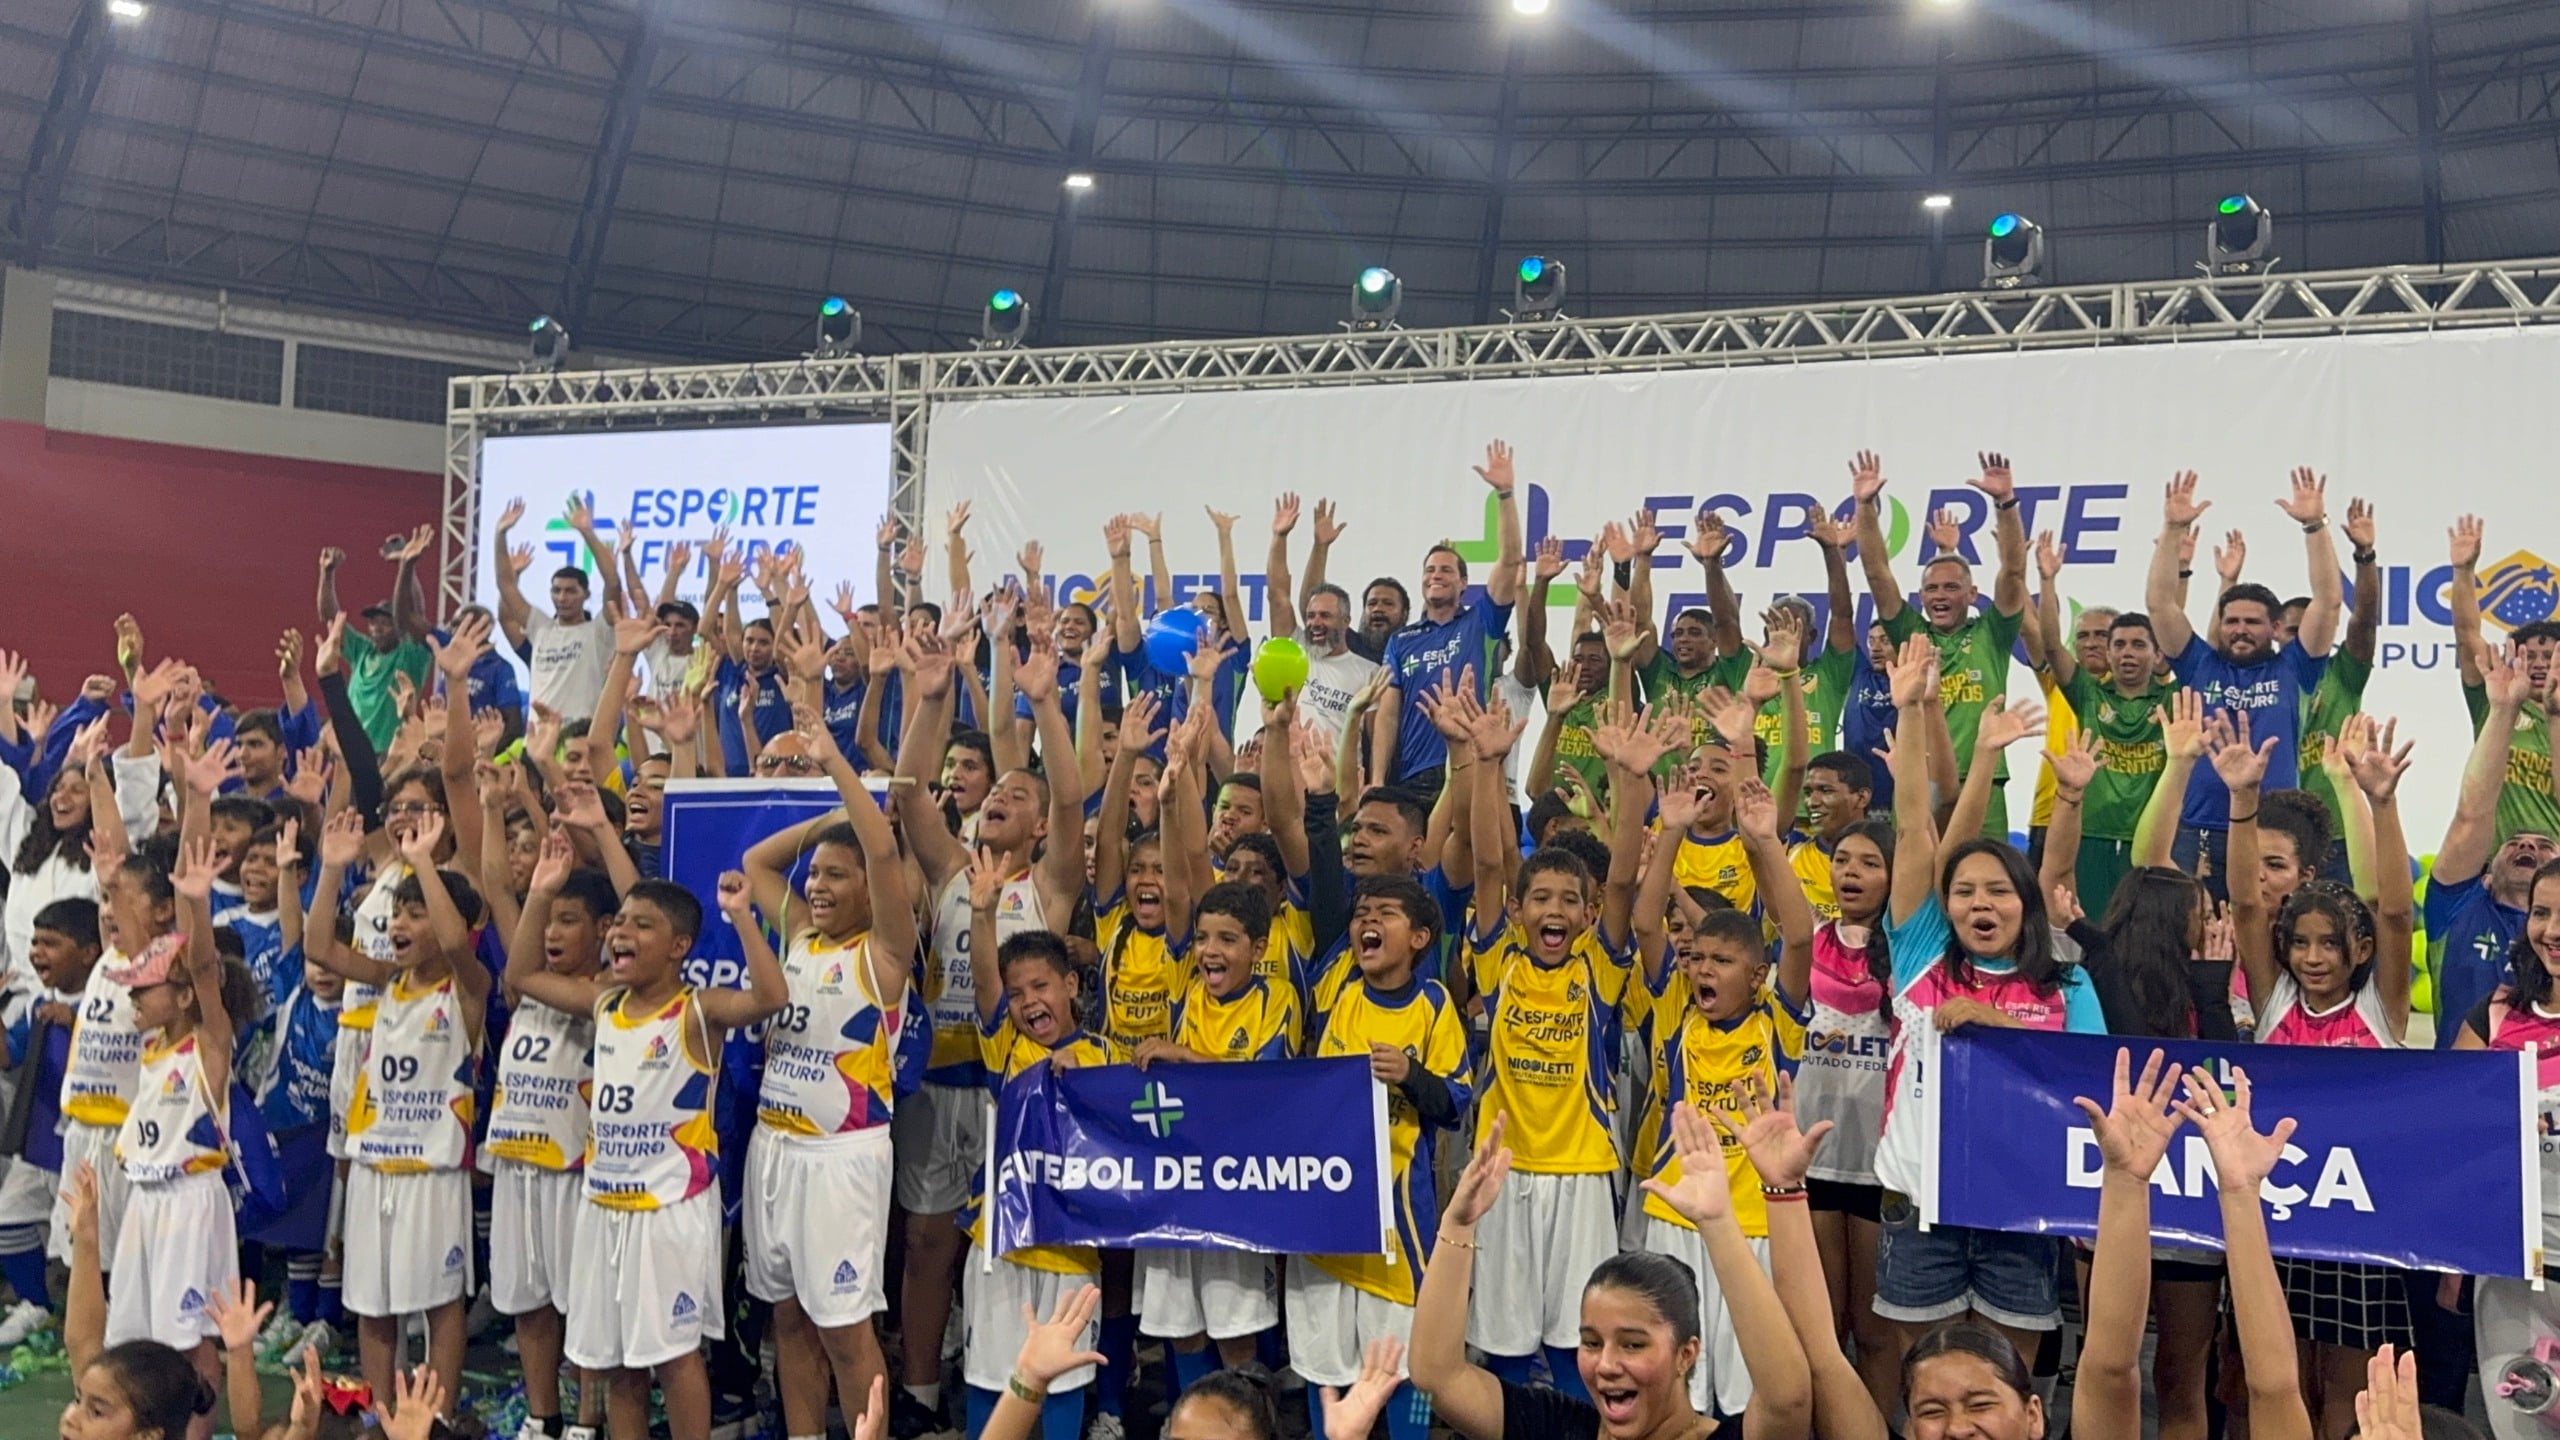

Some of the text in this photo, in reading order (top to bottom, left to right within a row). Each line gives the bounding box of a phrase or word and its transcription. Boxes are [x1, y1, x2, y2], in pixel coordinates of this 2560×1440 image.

[630, 485, 819, 528] ESPORTE
[1310, 679, 1354, 705] EPORTE
[777, 1002, 811, 1034] 03
[1524, 1010, 1584, 1028] ESPORTE
[1525, 1026, 1584, 1042] FUTURO
[512, 1034, 551, 1063] 02
[770, 1038, 834, 1067] ESPORTE
[381, 1055, 418, 1082] 09
[768, 1057, 825, 1083] FUTURO
[504, 1072, 577, 1095] ESPORTE
[382, 1088, 448, 1106] ESPORTE
[506, 1090, 569, 1110] FUTURO
[598, 1083, 635, 1113] 03
[596, 1121, 672, 1140] ESPORTE
[597, 1140, 665, 1158] FUTURO
[998, 1150, 1352, 1194] FUTEBOL DE CAMPO
